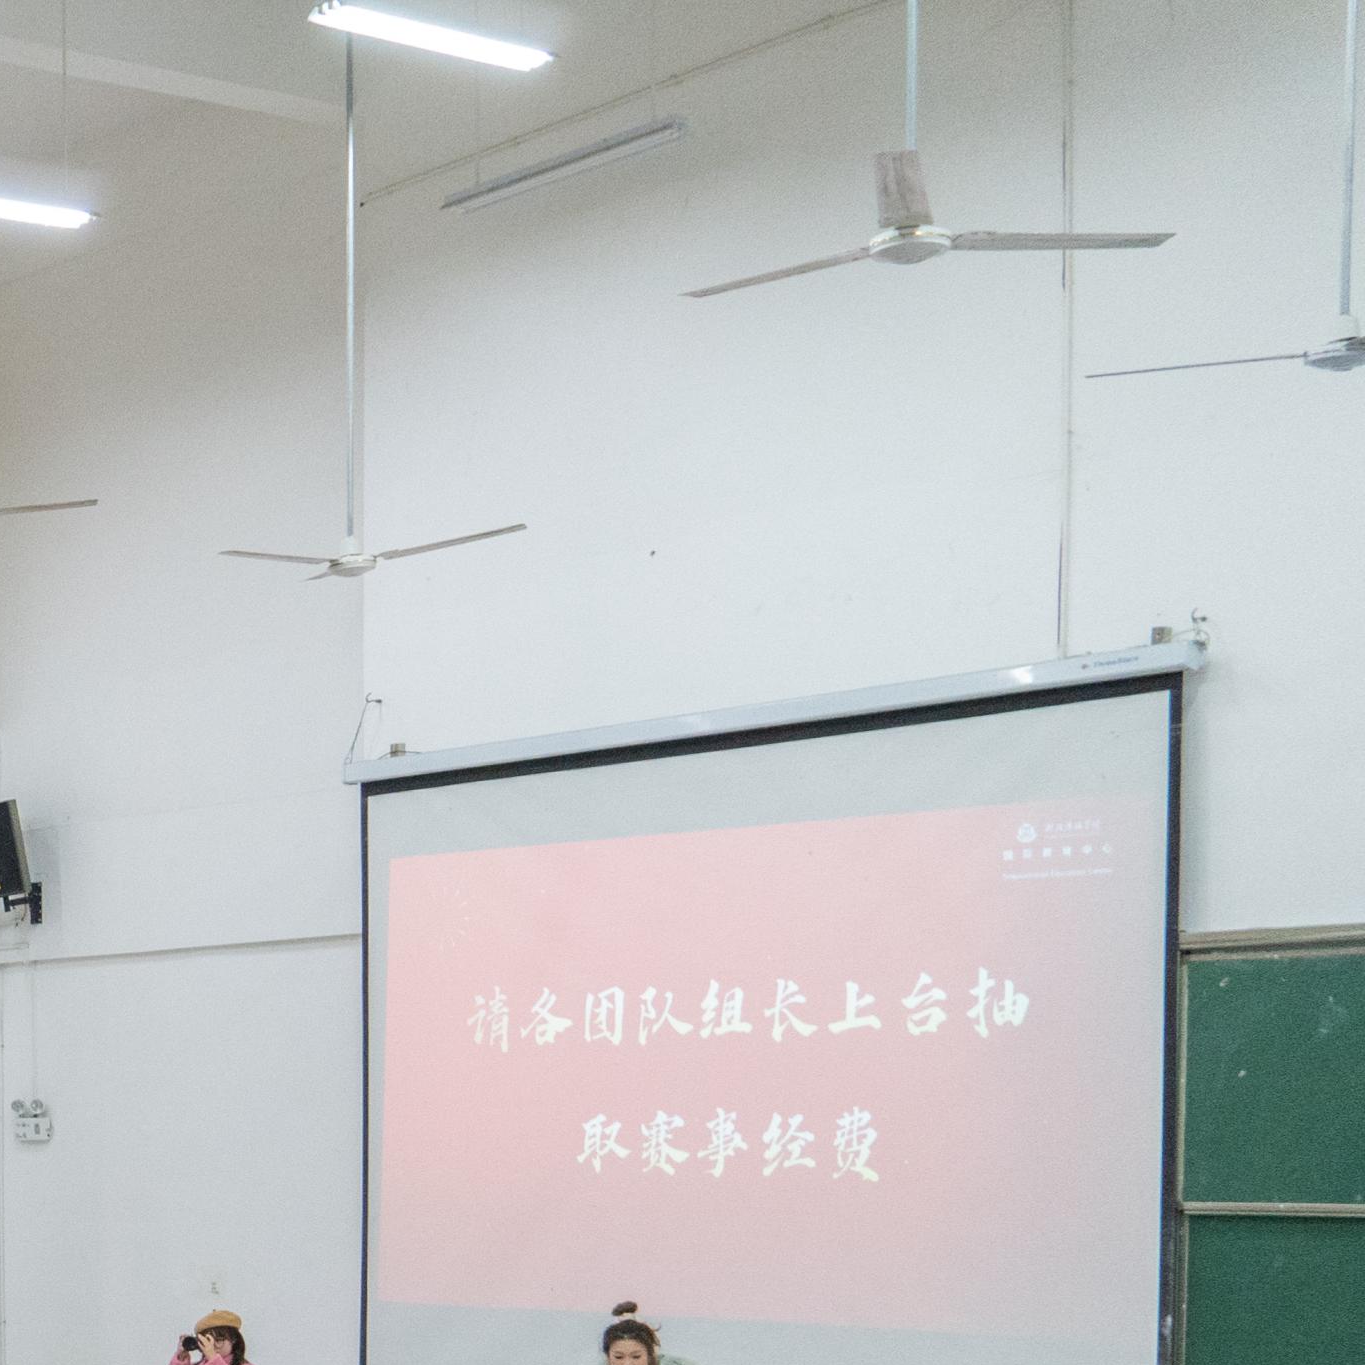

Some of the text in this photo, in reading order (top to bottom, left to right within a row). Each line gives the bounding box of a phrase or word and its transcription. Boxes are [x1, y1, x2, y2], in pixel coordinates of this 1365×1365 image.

[466, 966, 1031, 1053] 请各团队组长上台抽
[575, 1106, 880, 1182] 取赛事经费
